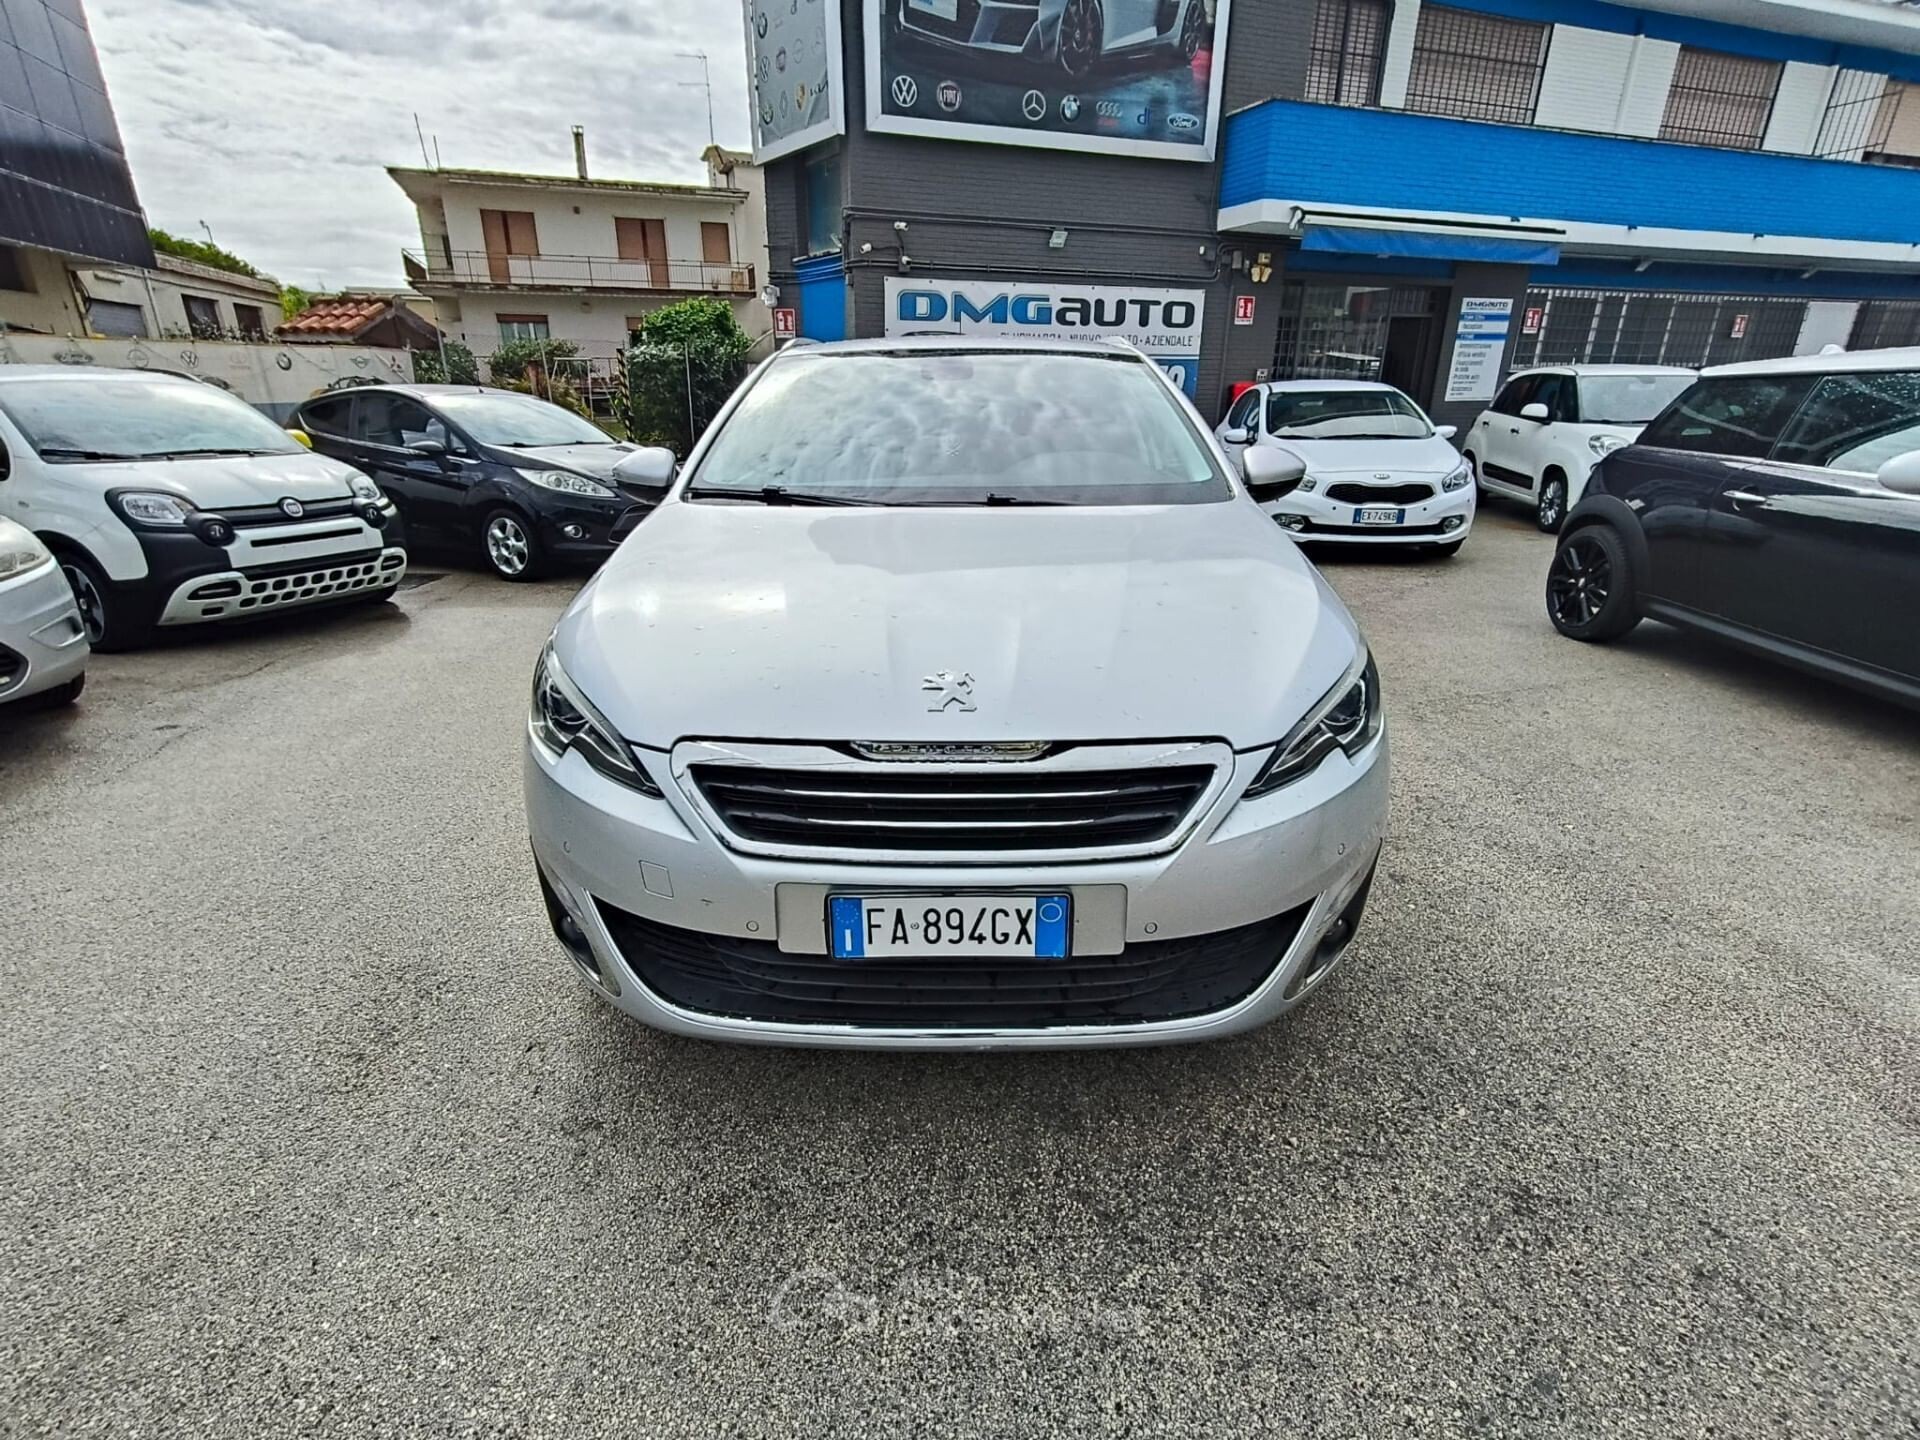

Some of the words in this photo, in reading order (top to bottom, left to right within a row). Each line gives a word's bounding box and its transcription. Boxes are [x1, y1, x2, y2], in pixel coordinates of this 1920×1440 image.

[1144, 334, 1194, 347] AZIENDALE
[866, 908, 909, 945] FA
[923, 908, 1033, 945] 894GX
